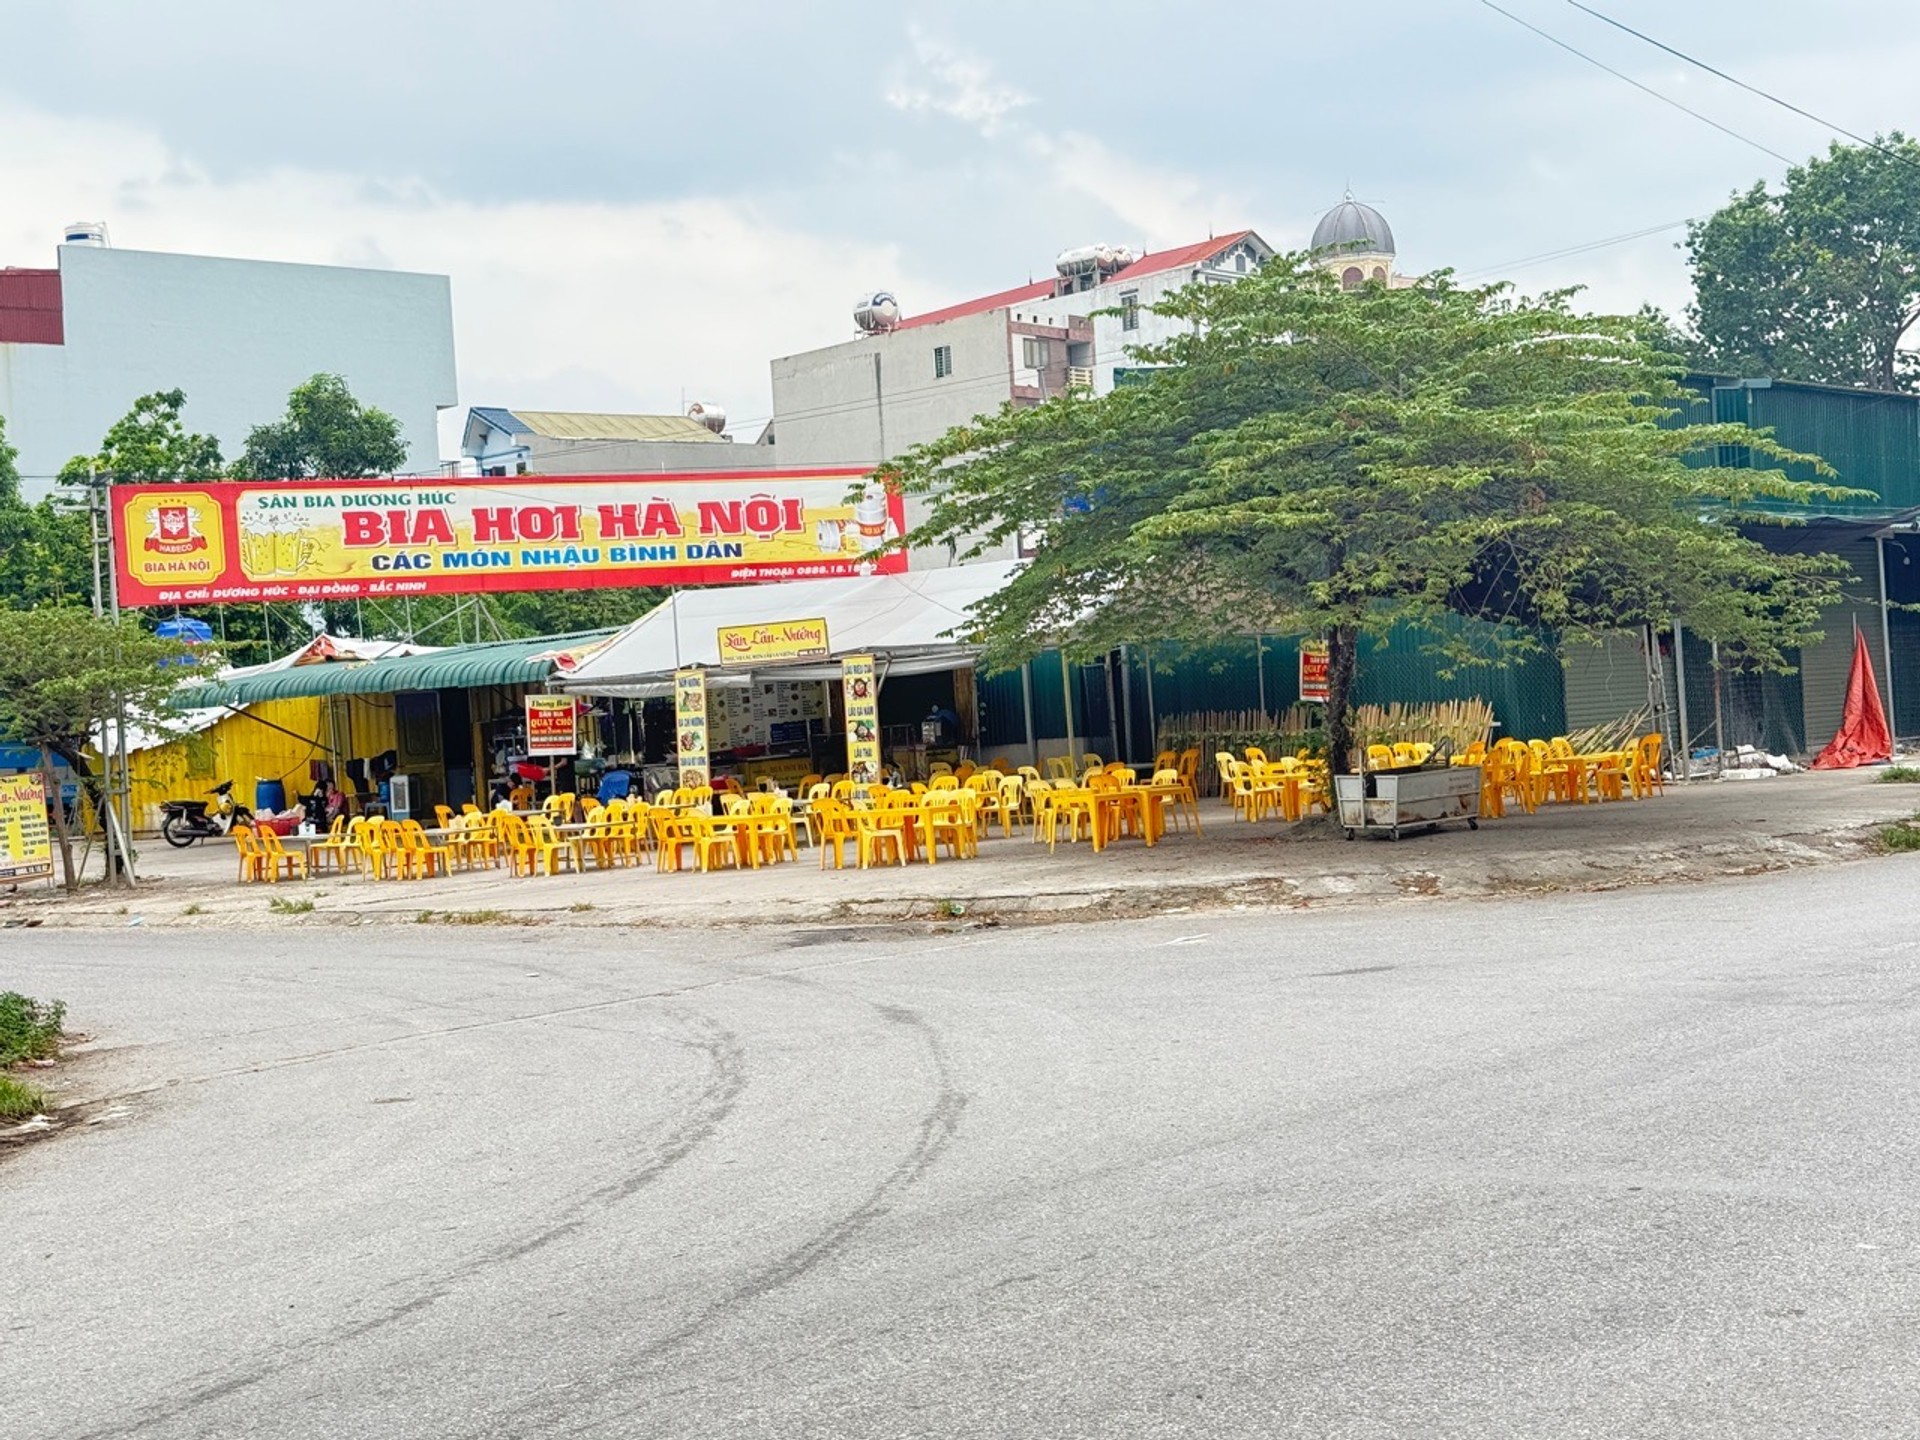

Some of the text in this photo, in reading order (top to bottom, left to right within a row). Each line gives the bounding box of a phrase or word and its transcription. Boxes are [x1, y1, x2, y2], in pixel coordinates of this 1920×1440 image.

[258, 491, 456, 509] SÂN BIA DƯƠNG HÚC
[341, 508, 456, 547] BIA
[597, 496, 682, 538] HÀ
[696, 493, 803, 539] NỘI
[158, 544, 193, 554] HABECO
[372, 540, 743, 571] CÁC MÓN NHẬU BÌNH DÂN
[144, 559, 210, 573] BIA HÀ NỘI
[731, 566, 756, 580] ĐIỆN
[158, 591, 182, 602] ĐỊA
[213, 586, 260, 598] DƯƠNG
[263, 584, 289, 597] HÚC
[297, 585, 320, 597] ĐẠI
[396, 582, 427, 591] NINH
